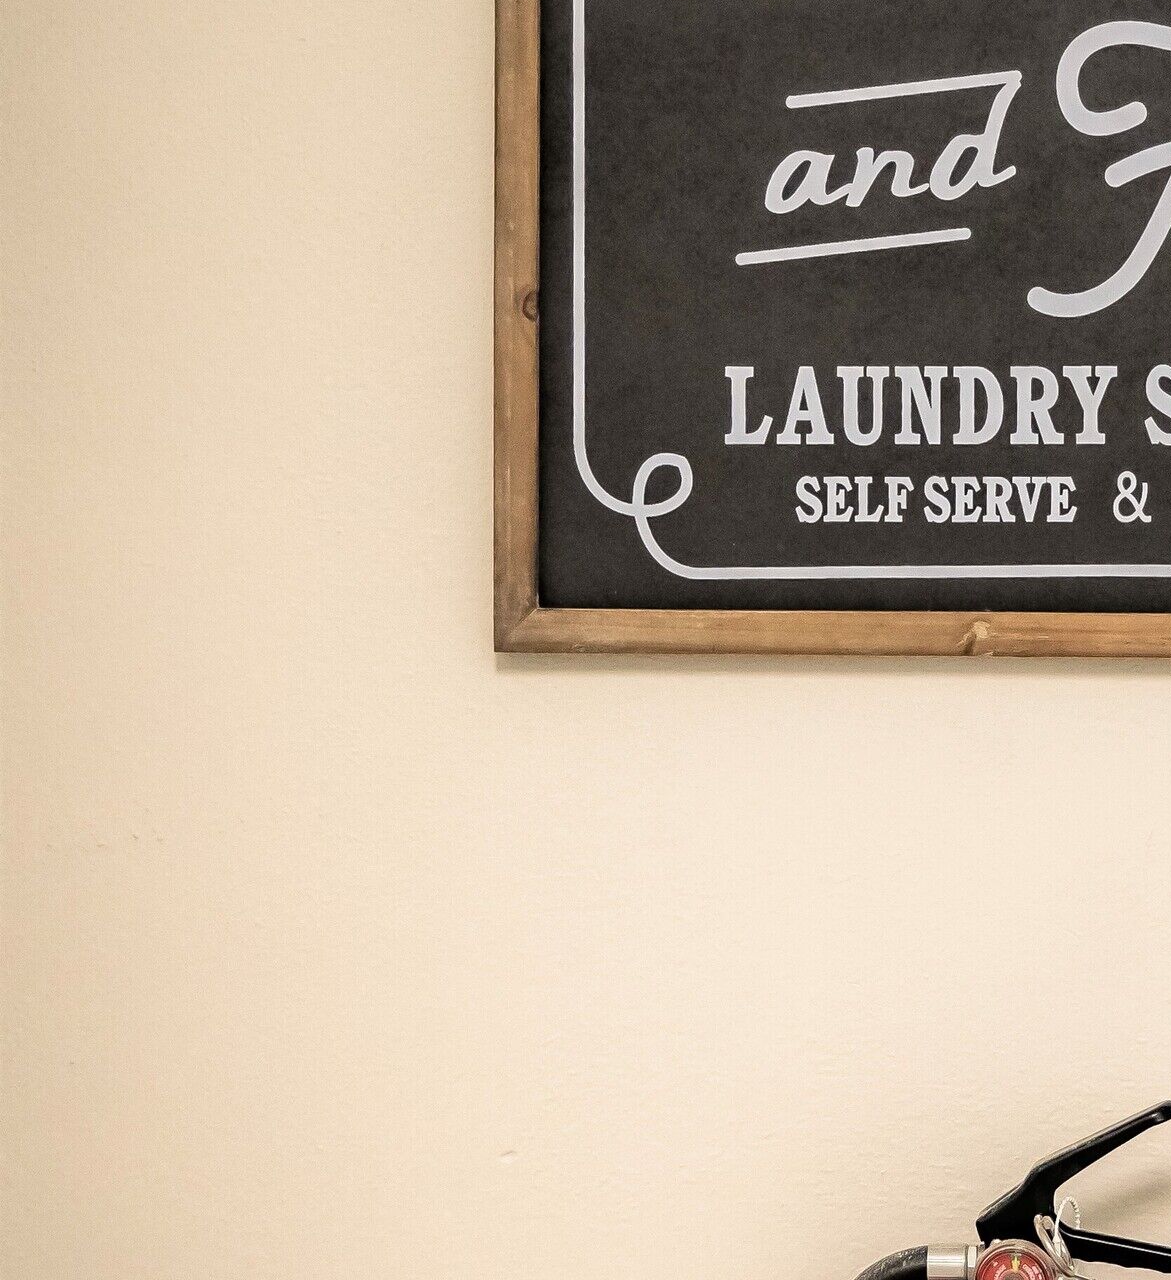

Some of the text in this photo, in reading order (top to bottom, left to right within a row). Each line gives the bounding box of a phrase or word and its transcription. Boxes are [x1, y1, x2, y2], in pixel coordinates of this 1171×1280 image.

[764, 70, 1023, 214] and
[725, 365, 1118, 447] LAUNDRY
[795, 475, 914, 524] SELF
[924, 475, 1078, 524] SERVE
[1112, 470, 1152, 523] &
